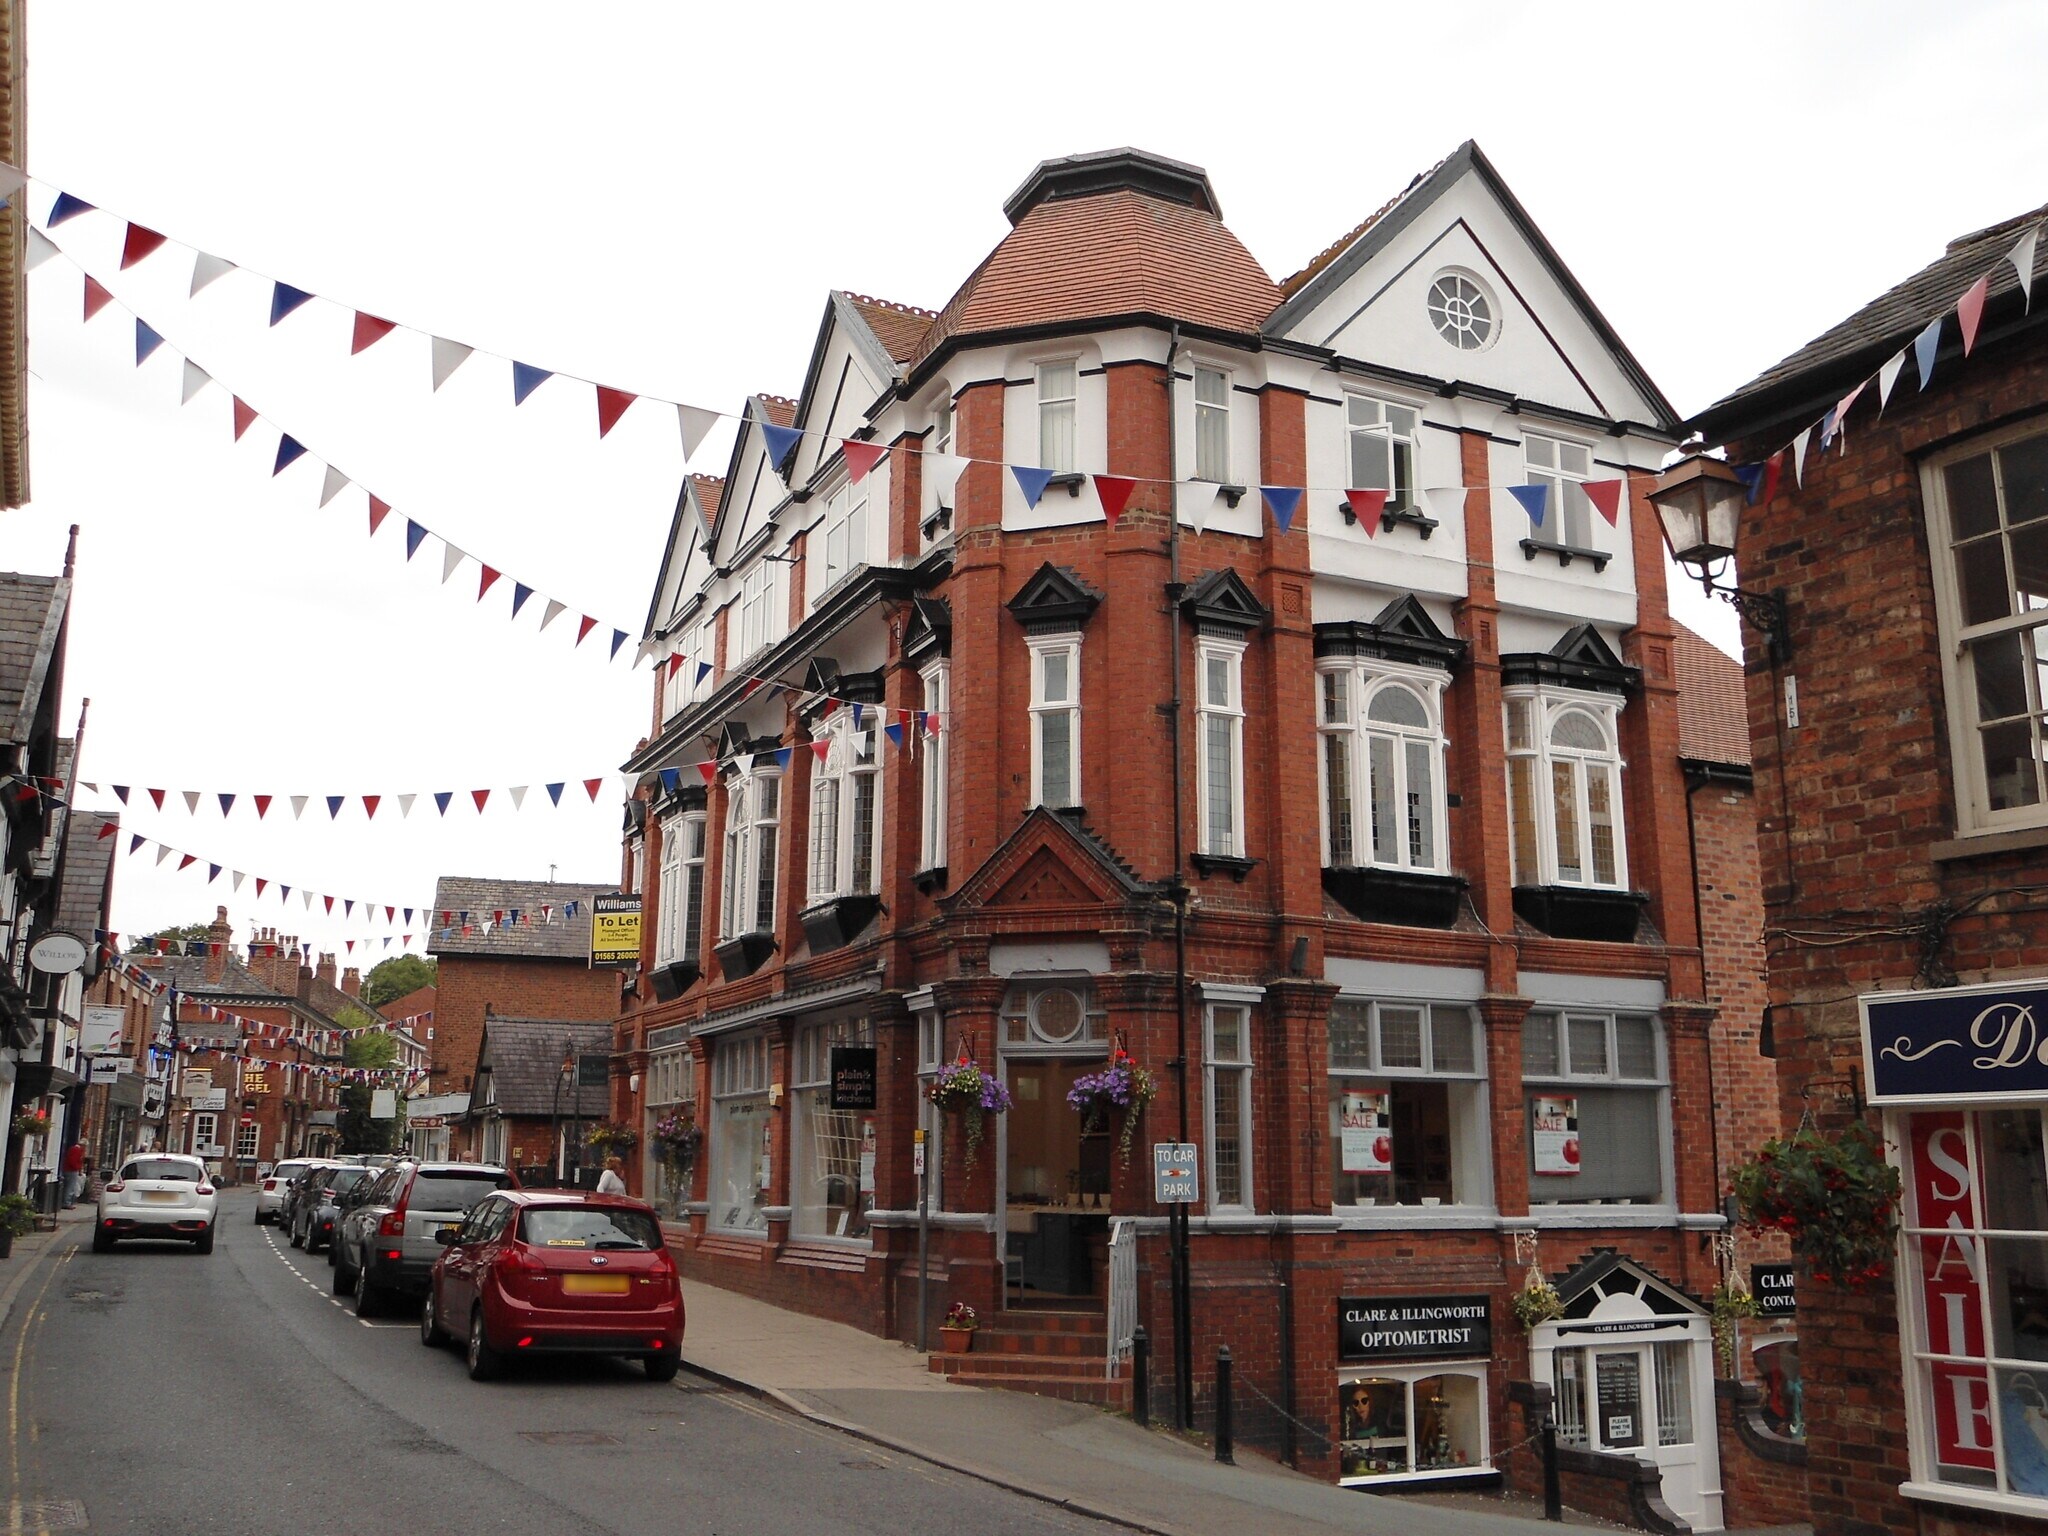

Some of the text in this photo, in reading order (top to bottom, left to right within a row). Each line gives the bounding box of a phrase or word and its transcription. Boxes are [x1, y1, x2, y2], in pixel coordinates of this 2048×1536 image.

[597, 899, 642, 910] Williams
[599, 916, 639, 927] To Let
[595, 952, 616, 960] 01565
[836, 1080, 872, 1096] simple
[836, 1094, 872, 1103] kitchens
[1343, 1113, 1373, 1129] SALE
[1535, 1117, 1562, 1132] SALE
[1157, 1150, 1194, 1163] TO CAR
[1163, 1183, 1191, 1196] PARK
[1346, 1306, 1486, 1323] CLARE & ILLINGWORTH
[1618, 1322, 1656, 1331] ILLINGWORTH
[1360, 1328, 1471, 1348] OPTOMETRIST
